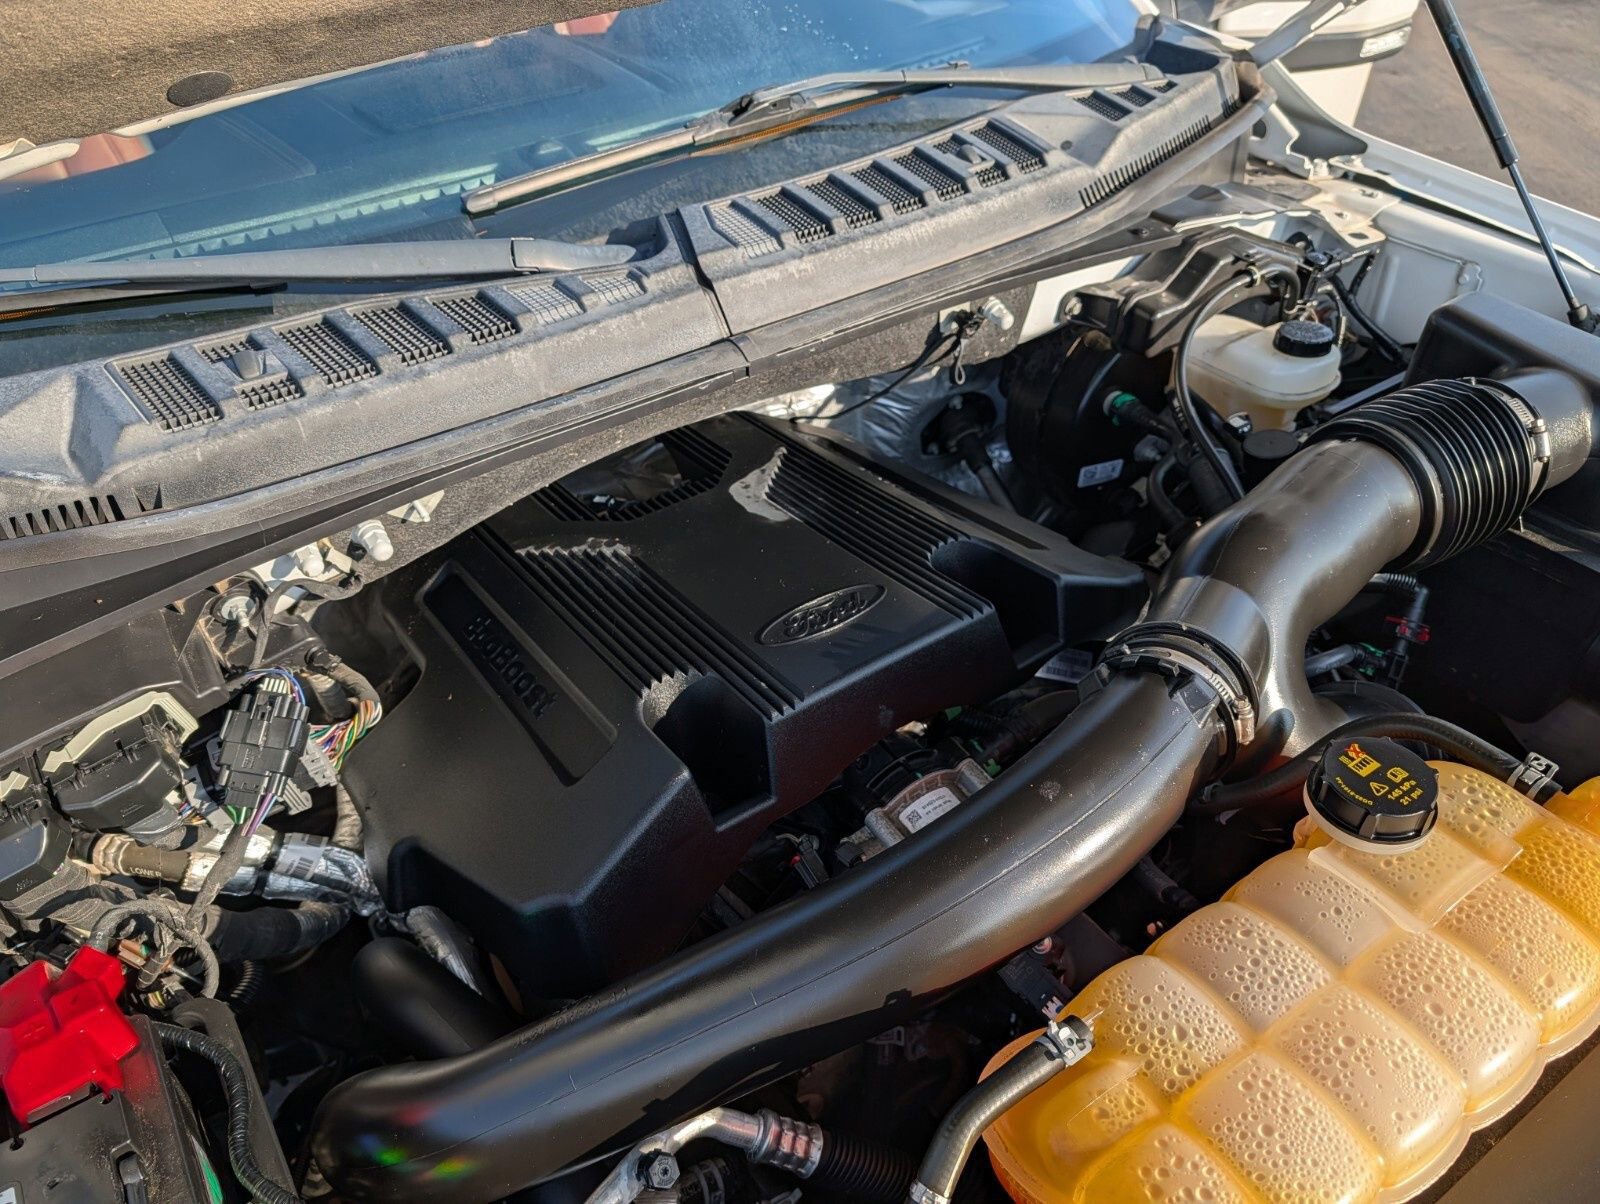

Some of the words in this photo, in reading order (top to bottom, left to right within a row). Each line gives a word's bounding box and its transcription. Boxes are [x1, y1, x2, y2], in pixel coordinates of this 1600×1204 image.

[782, 591, 868, 638] Ford
[1388, 788, 1403, 801] 145
[1400, 780, 1417, 792] kPa
[1399, 797, 1411, 806] 21
[1410, 788, 1424, 801] psi
[129, 866, 162, 878] LOWER
